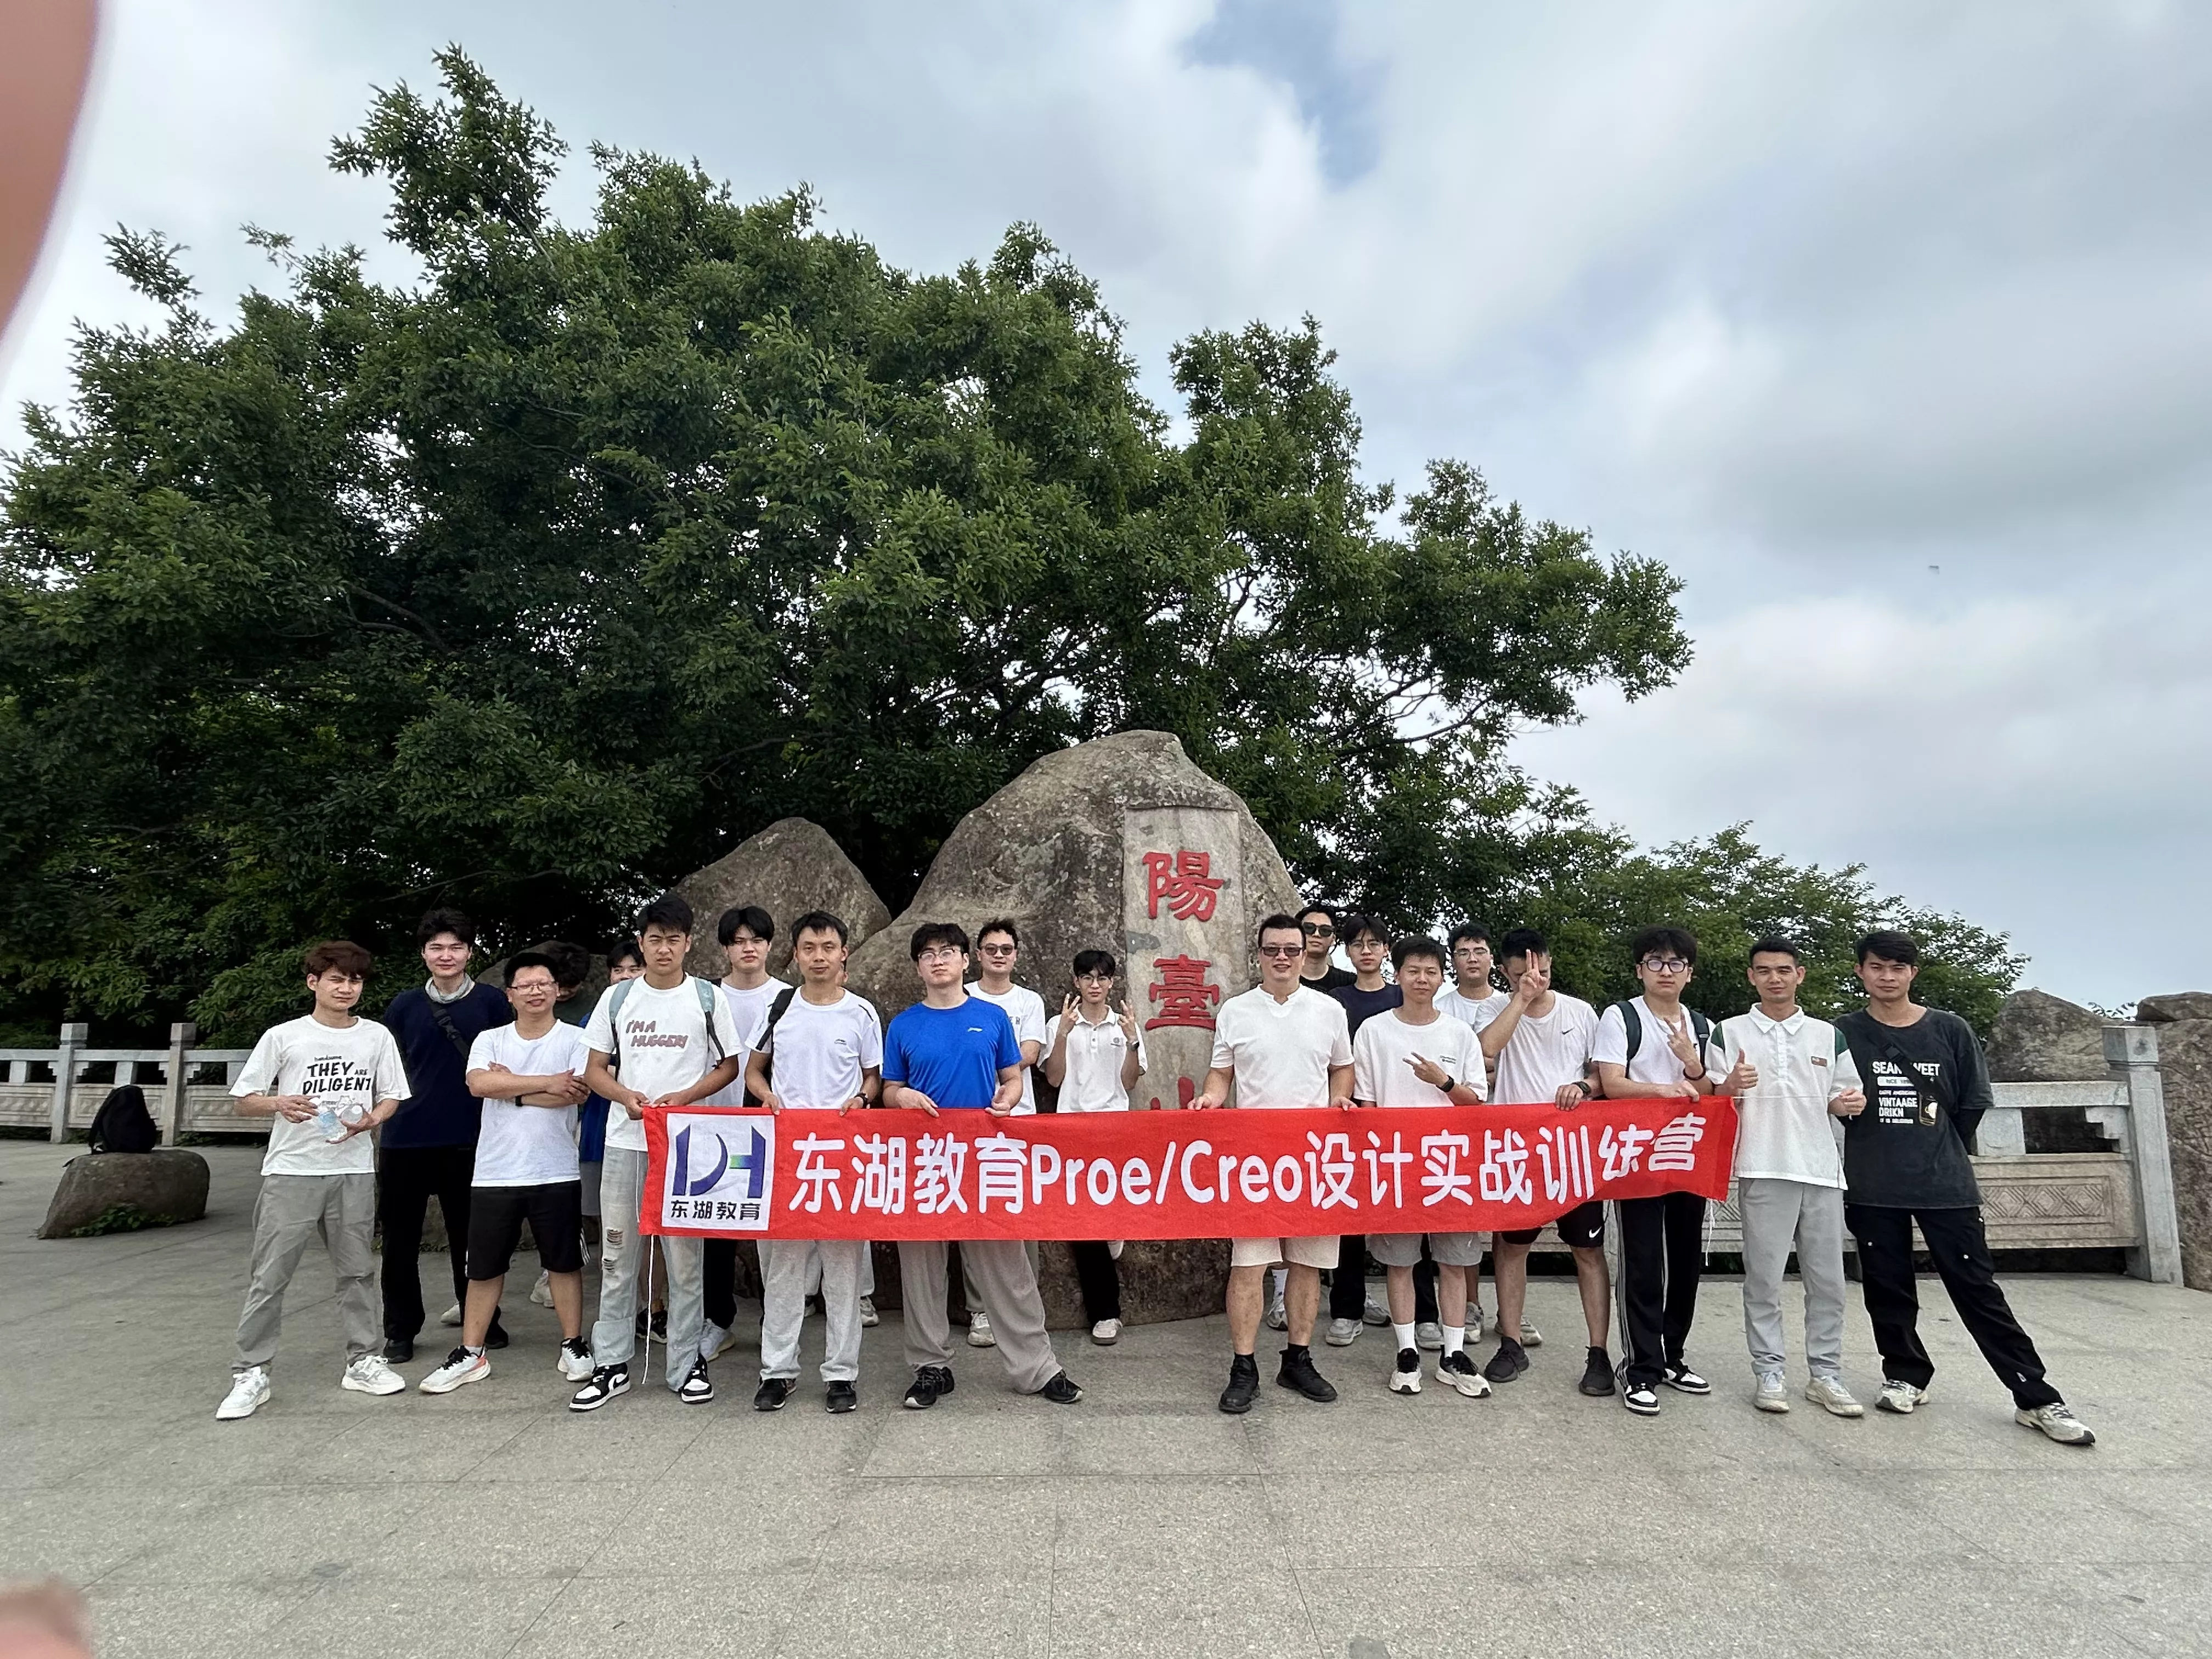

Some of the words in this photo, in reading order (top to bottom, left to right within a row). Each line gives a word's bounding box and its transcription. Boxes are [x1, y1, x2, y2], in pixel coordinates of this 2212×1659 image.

[306, 1061, 355, 1077] THEY
[302, 1076, 371, 1095] DILIGENT
[670, 1199, 761, 1220] 东湖教育
